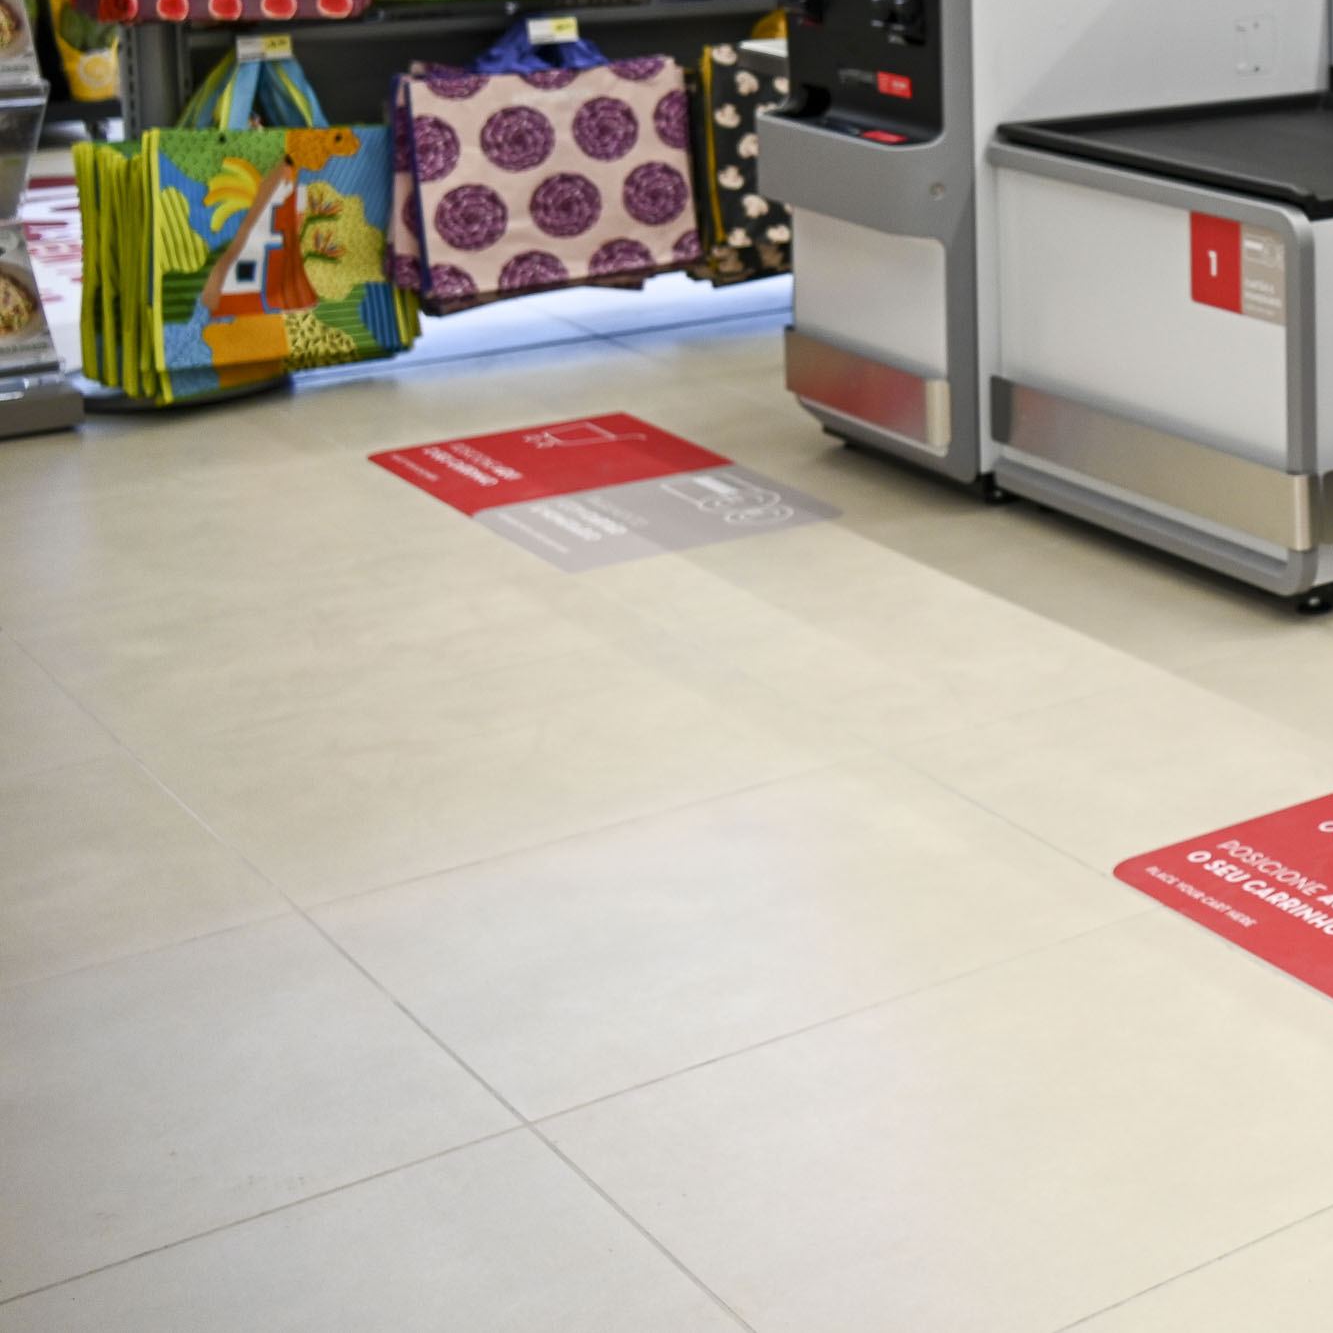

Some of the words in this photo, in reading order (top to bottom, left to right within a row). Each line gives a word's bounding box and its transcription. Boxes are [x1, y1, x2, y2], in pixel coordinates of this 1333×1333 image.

[1208, 250, 1218, 277] 1
[1186, 850, 1213, 864] O
[1203, 859, 1252, 883] SEU
[1216, 839, 1329, 896] POSICIONE
[1144, 866, 1179, 885] PLACE
[1176, 882, 1206, 900] YOUR
[1200, 896, 1232, 913] CART
[1225, 910, 1257, 928] HERE
